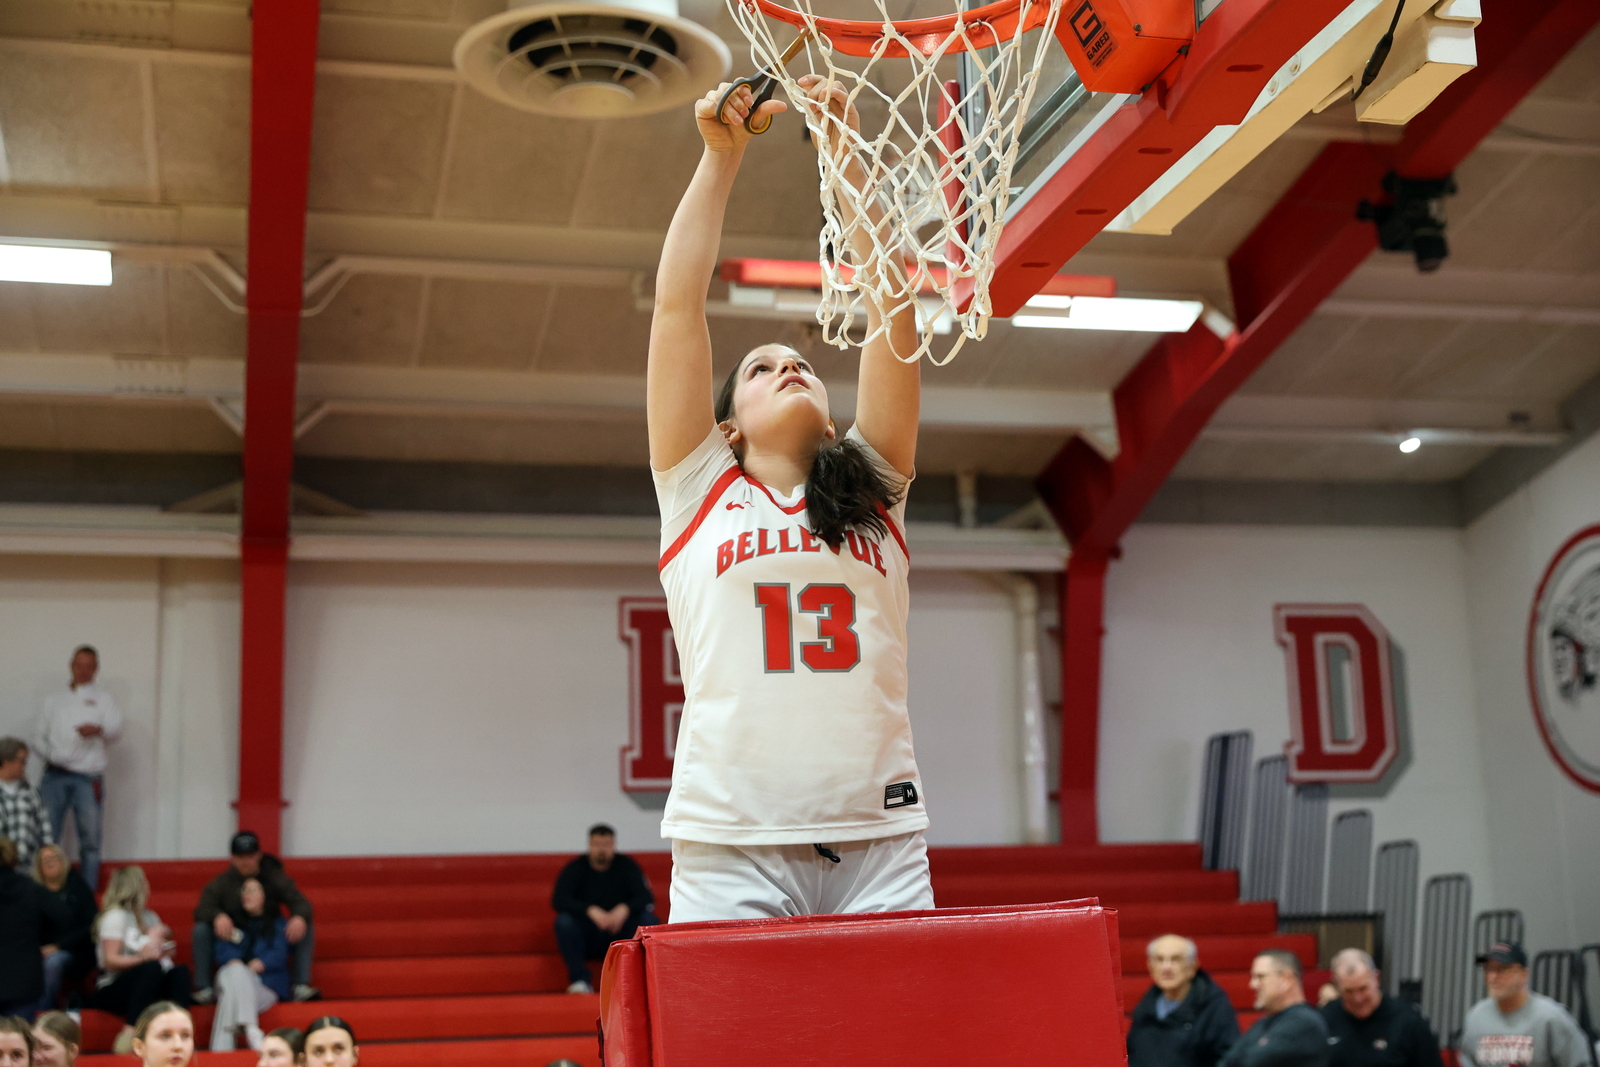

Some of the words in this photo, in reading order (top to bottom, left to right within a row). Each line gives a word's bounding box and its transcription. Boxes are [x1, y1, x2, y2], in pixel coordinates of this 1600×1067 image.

[1069, 0, 1103, 48] G
[1086, 31, 1110, 60] GARED
[753, 582, 861, 673] 13
[1272, 603, 1398, 784] D
